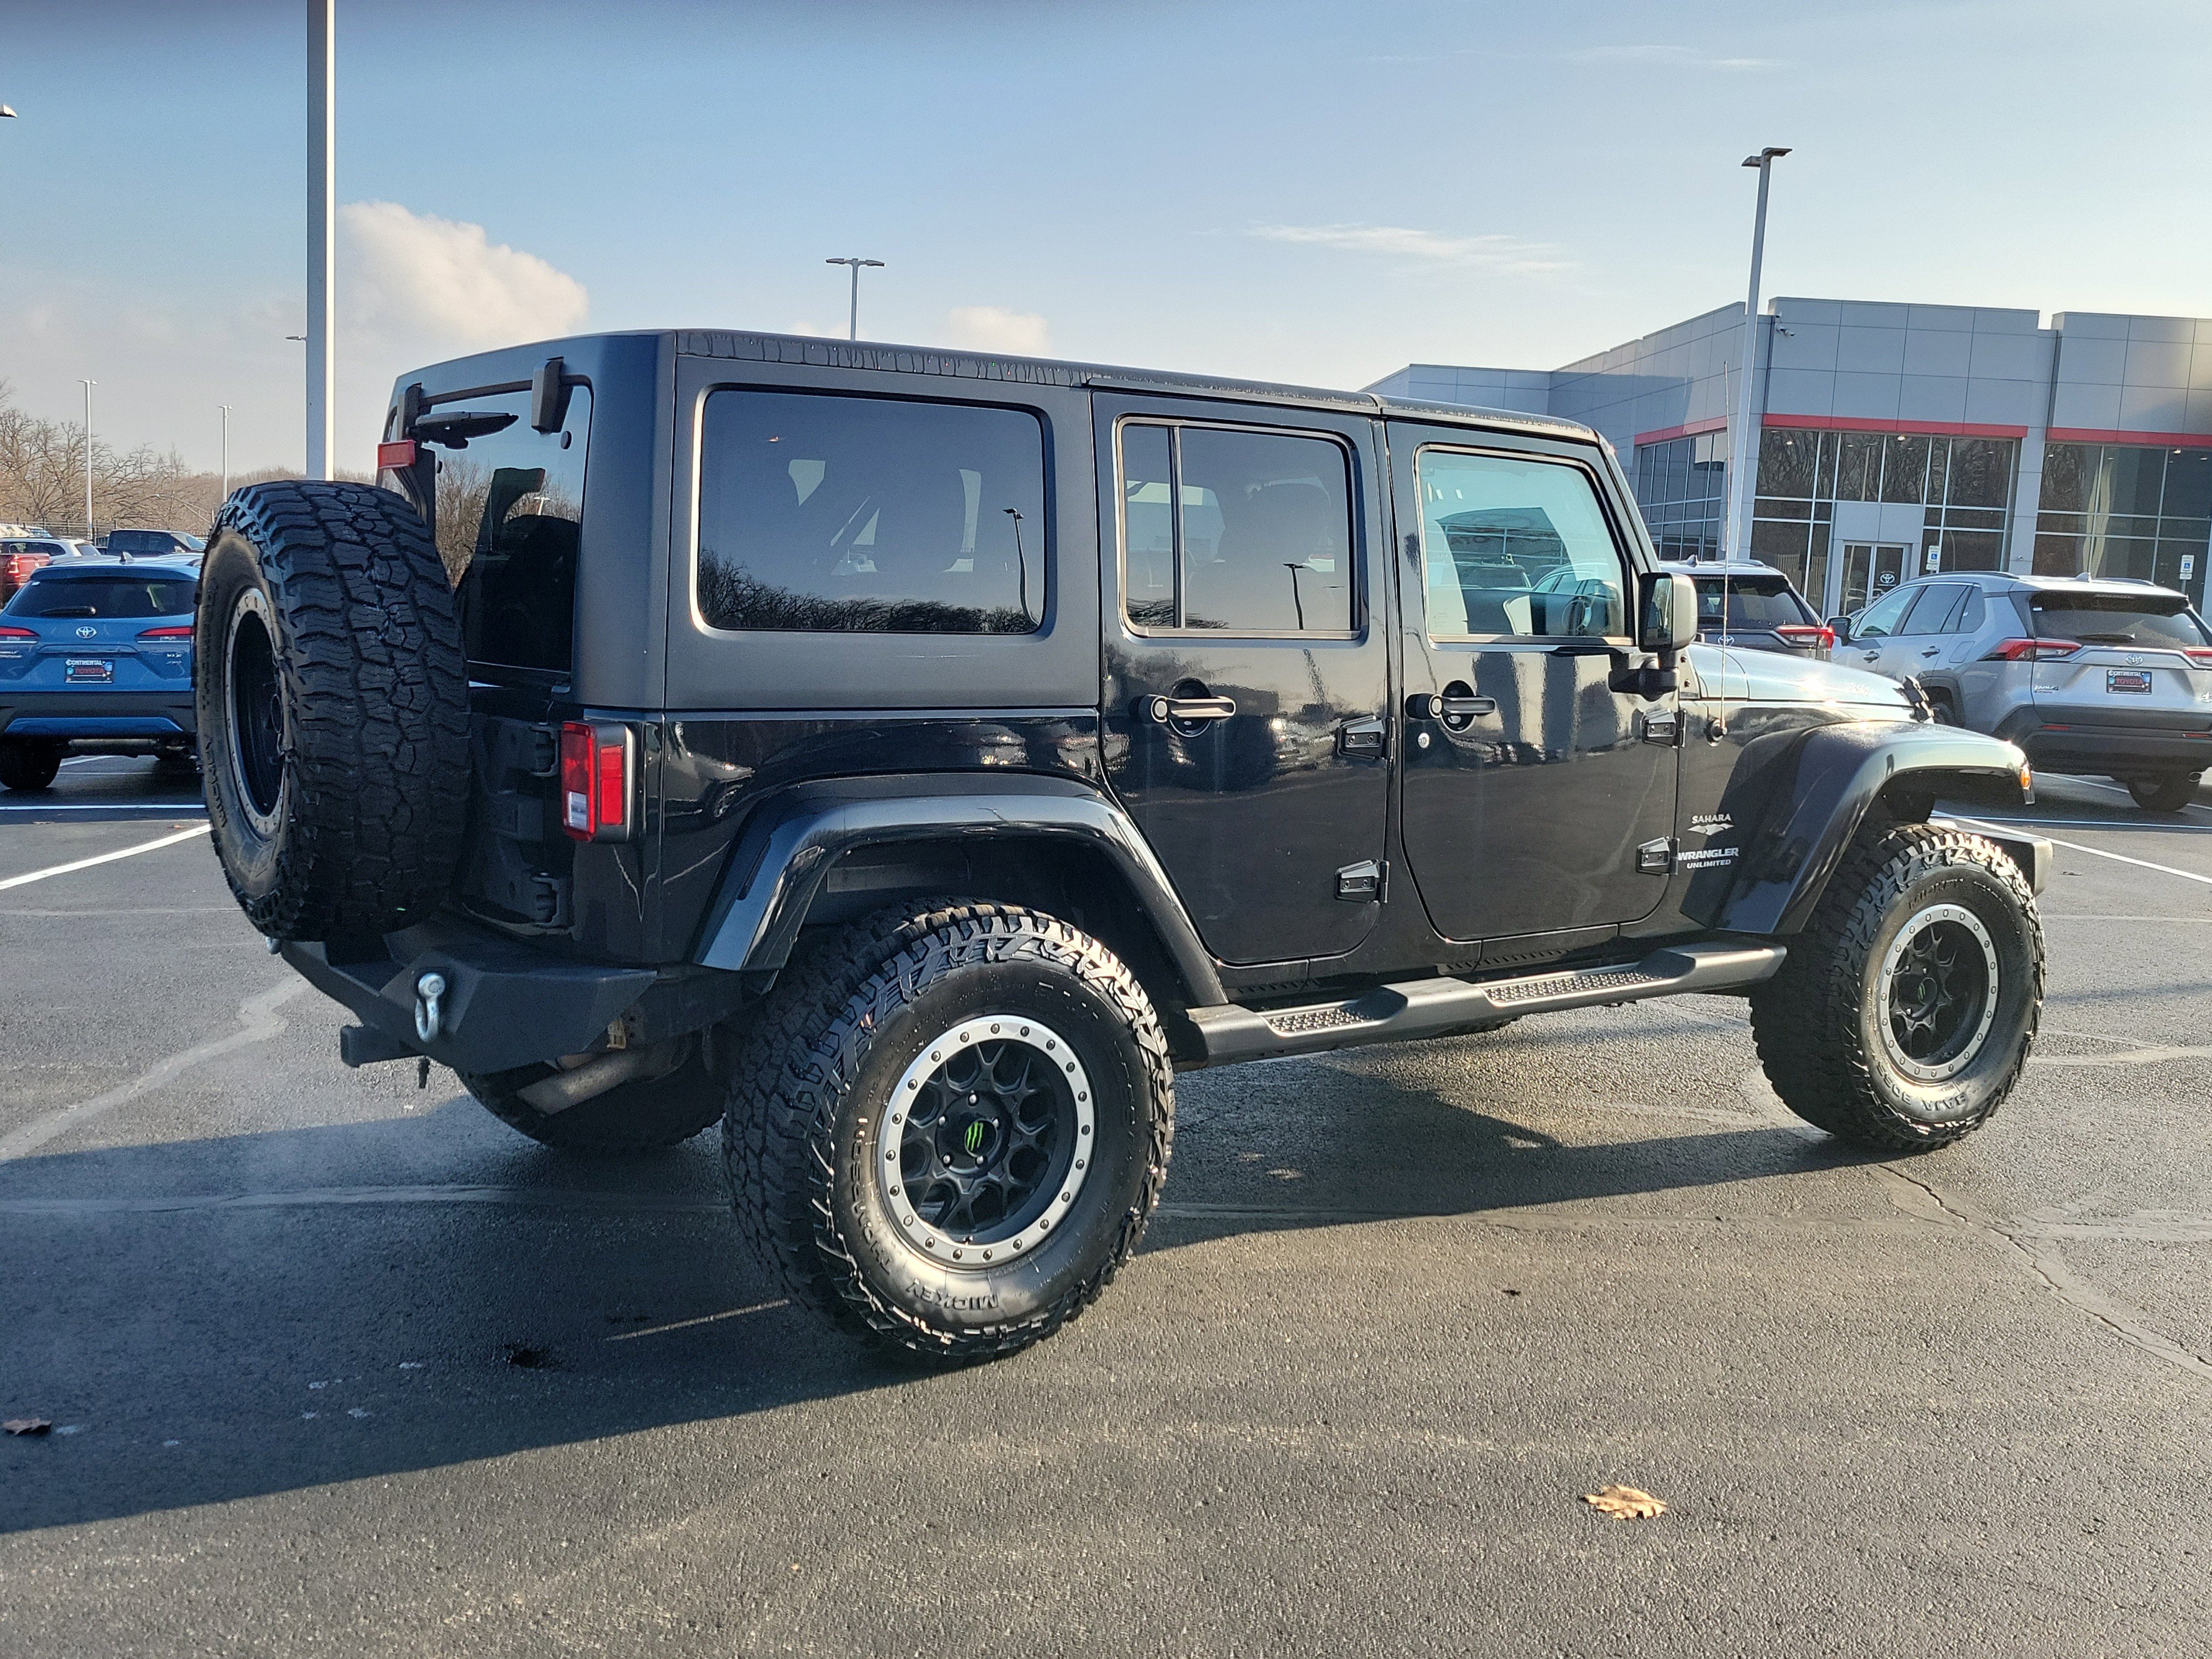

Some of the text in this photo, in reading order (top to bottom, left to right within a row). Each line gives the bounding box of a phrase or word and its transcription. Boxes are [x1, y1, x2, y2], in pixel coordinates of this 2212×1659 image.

[1691, 813, 1731, 824] SAHARA
[1678, 847, 1739, 861] WRANGLER
[1686, 859, 1731, 869] UNLIMITED
[1921, 1092, 1968, 1111] BAJA
[906, 1278, 999, 1310] MICKEY
